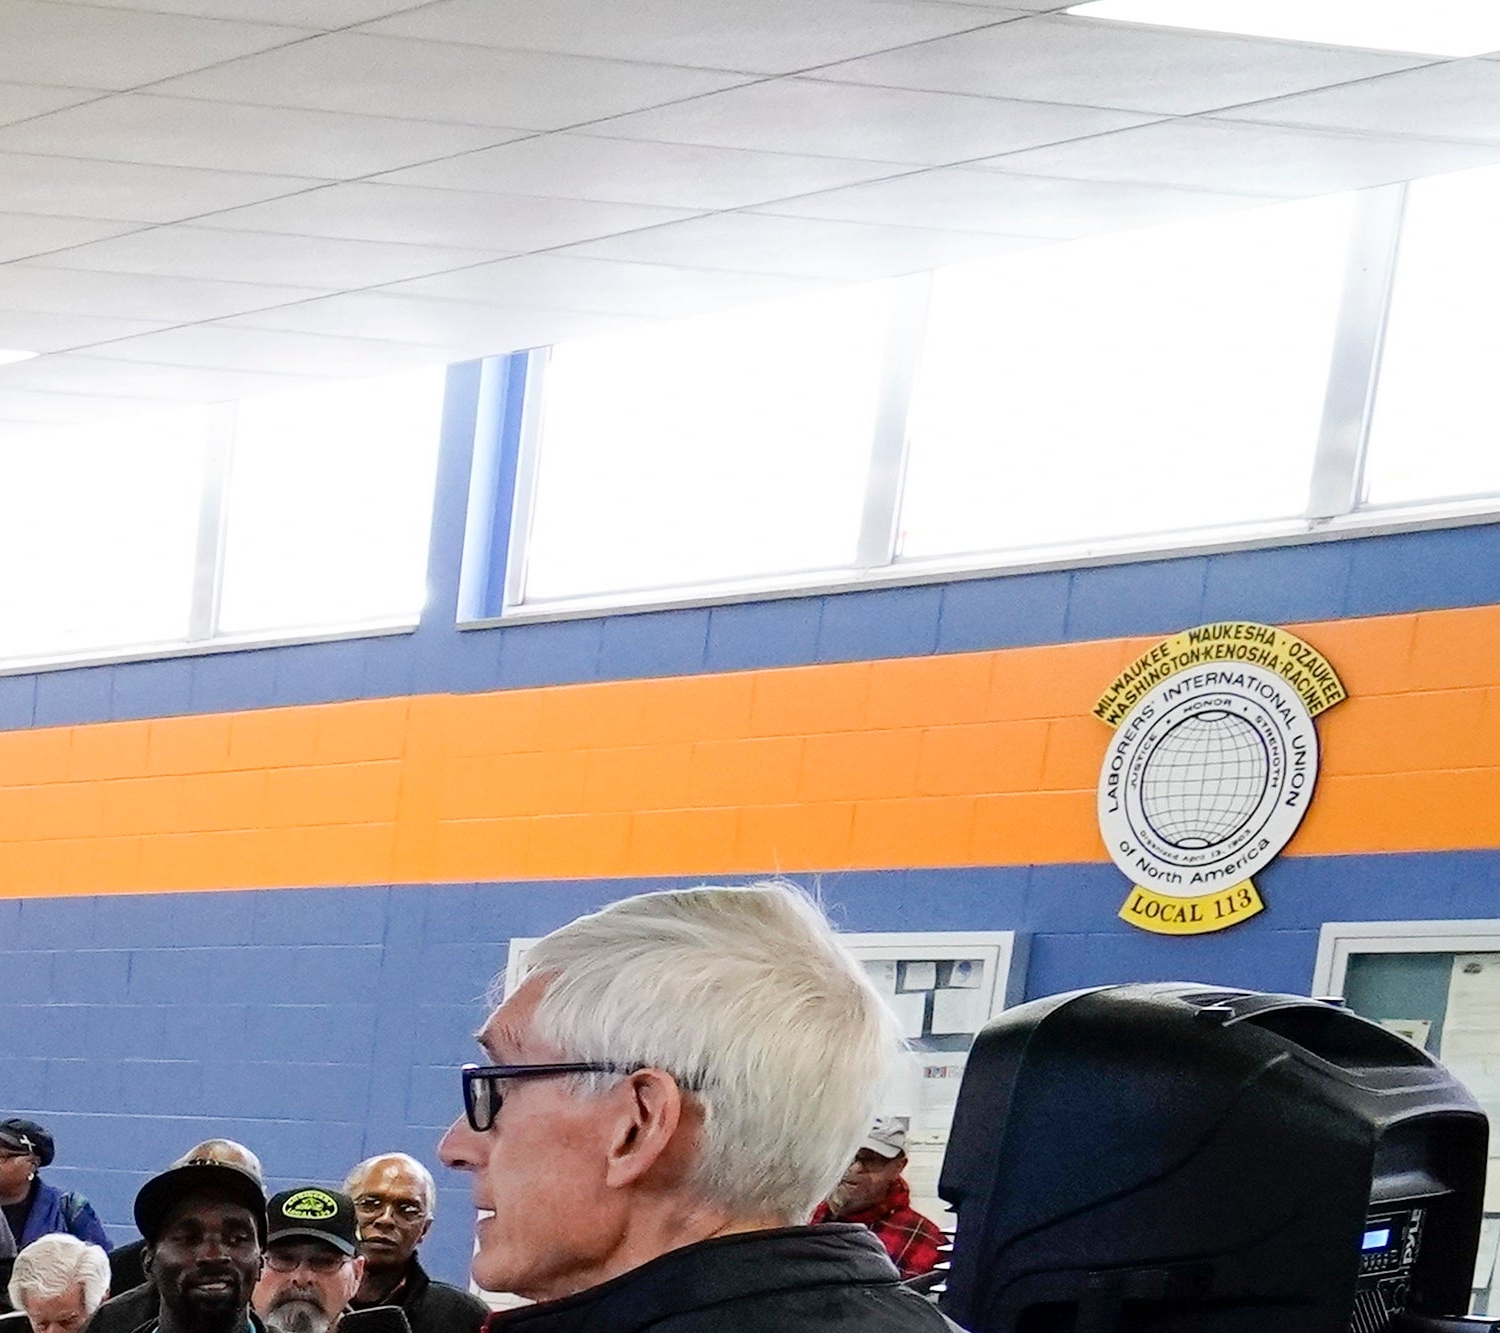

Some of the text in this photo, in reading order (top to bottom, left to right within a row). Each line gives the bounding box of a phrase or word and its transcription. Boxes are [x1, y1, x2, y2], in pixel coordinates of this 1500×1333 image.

[1093, 624, 1342, 718] MILWAUKEE WAUKESHA OZAUKEE
[1107, 644, 1324, 725] WASHINGTON KENOSHA RACINE
[1130, 733, 1158, 791] JUSTICE
[1183, 698, 1232, 714] HONOR
[1163, 672, 1299, 730] INTERNATIONAL
[1285, 735, 1305, 806] UNION
[1120, 838, 1270, 885] of North America
[1130, 888, 1253, 923] LOCAL 113
[1403, 1209, 1422, 1264] PYLE
